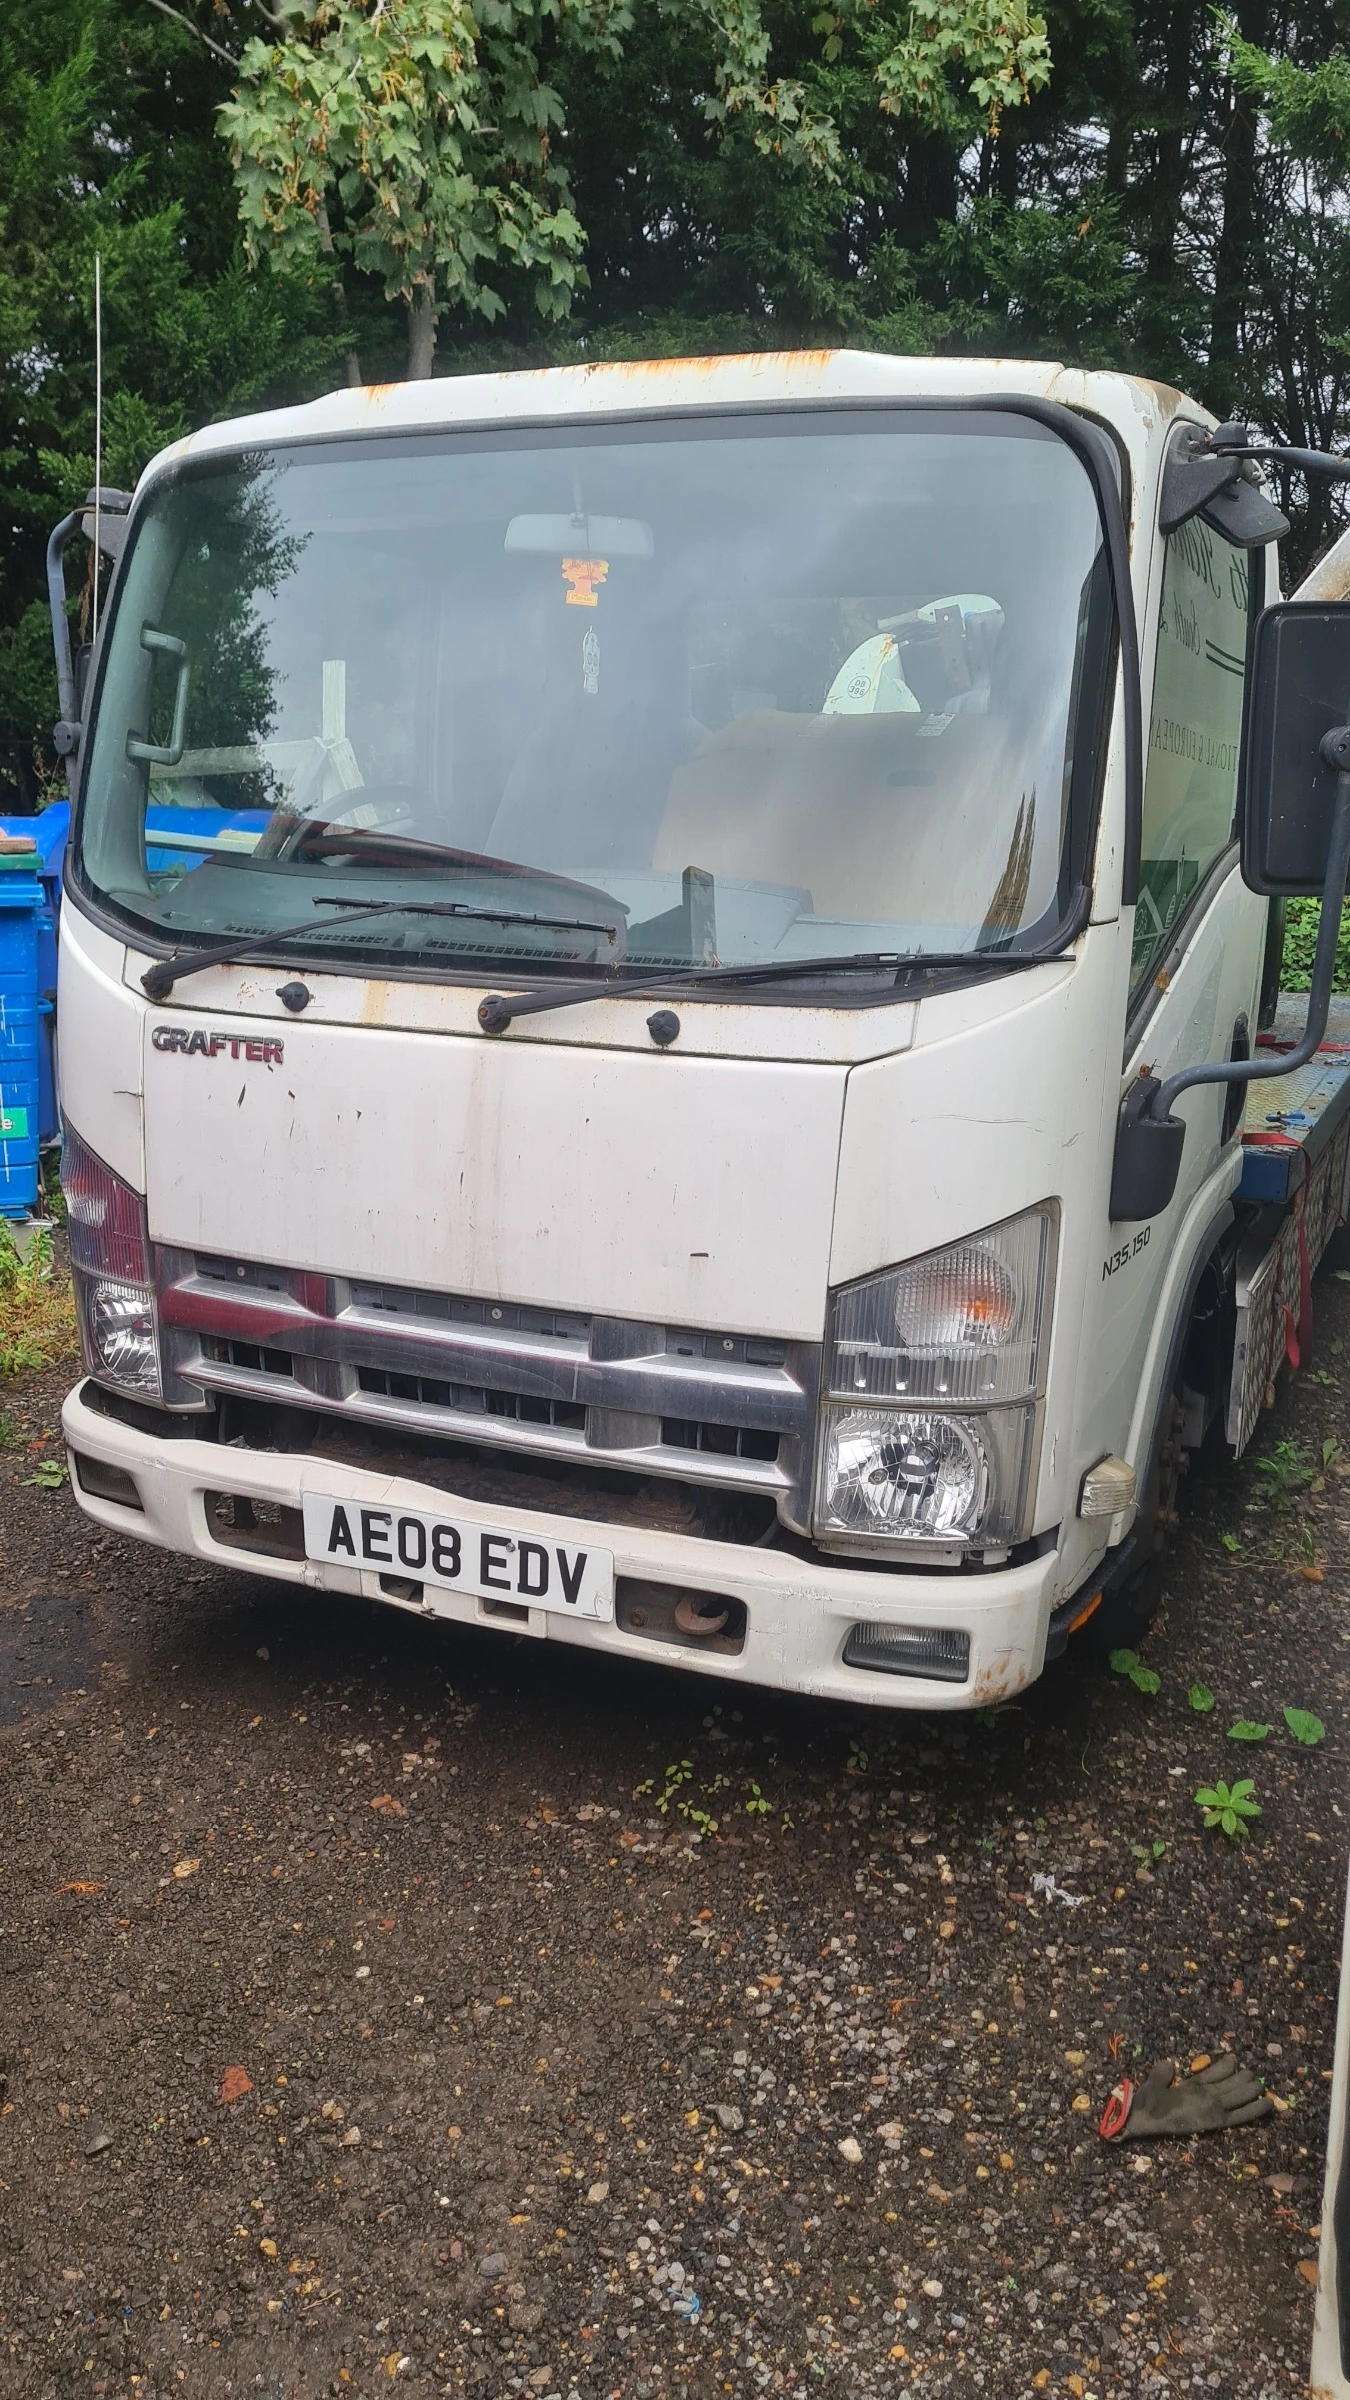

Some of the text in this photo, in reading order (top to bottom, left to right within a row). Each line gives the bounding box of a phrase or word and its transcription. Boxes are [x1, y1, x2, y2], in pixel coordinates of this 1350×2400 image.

[152, 1025, 284, 1064] GRAFTER
[1102, 1225, 1151, 1281] N35.150
[328, 1505, 588, 1605] AE08 EDV
